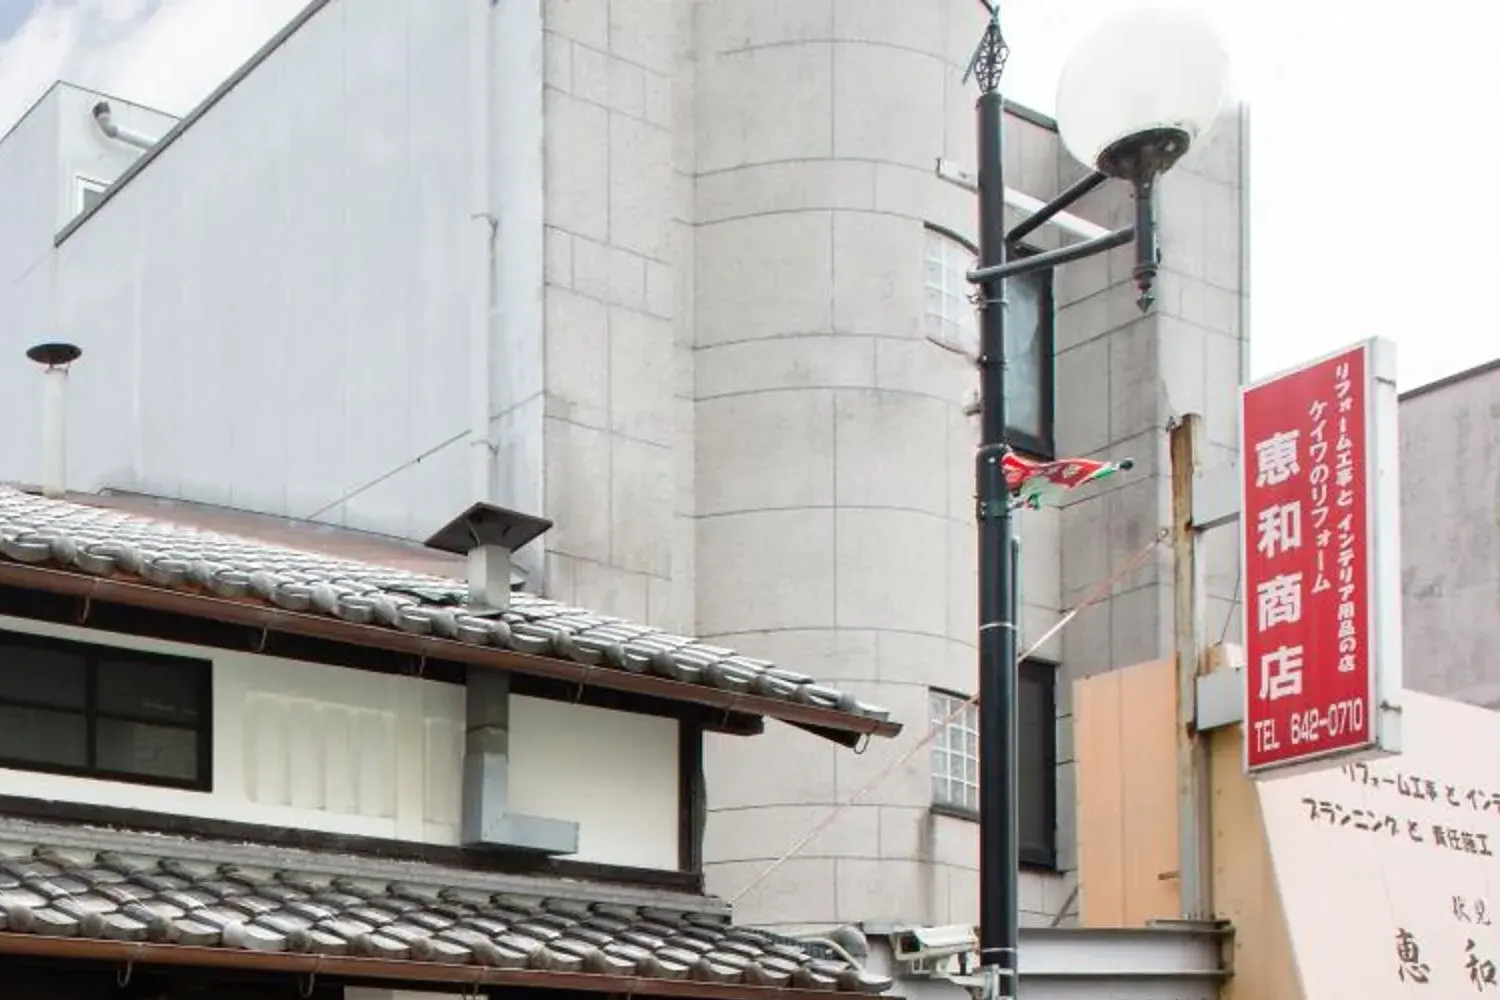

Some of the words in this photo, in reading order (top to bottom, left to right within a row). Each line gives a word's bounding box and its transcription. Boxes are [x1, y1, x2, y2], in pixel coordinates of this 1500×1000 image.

[1254, 428, 1303, 702] 恵和商店
[1308, 400, 1332, 595] ケイワのリフォーム
[1254, 718, 1281, 753] TEL
[1291, 697, 1363, 745] 642-0710
